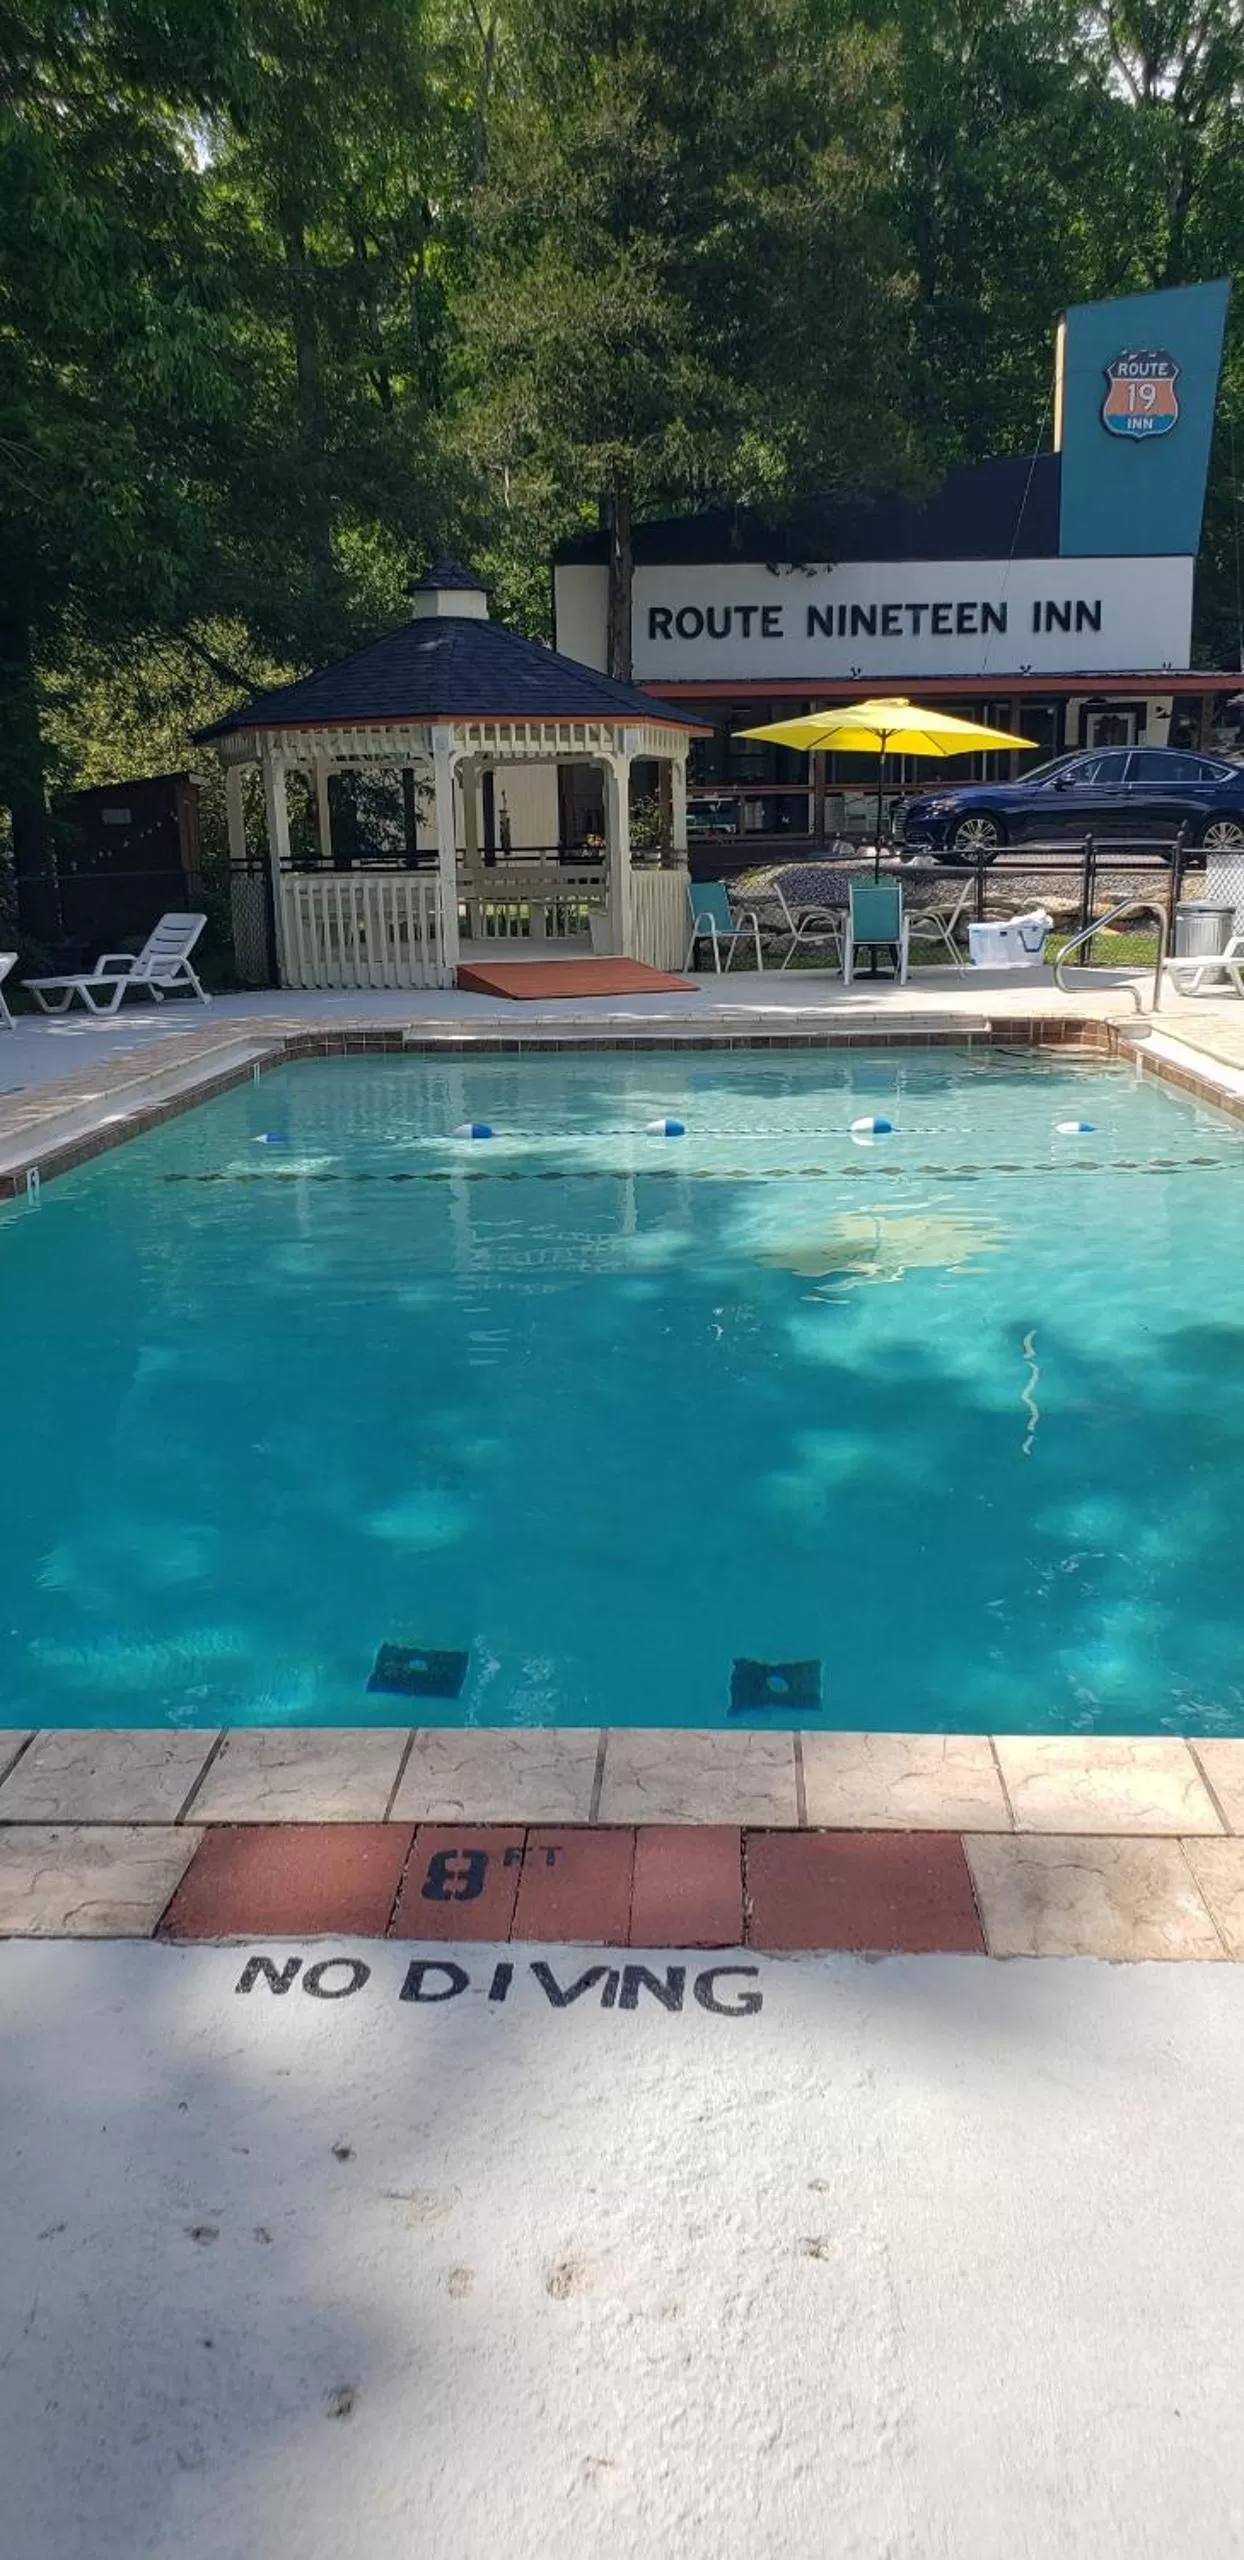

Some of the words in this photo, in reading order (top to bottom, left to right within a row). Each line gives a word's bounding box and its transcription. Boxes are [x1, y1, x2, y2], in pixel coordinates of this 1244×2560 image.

[1117, 362, 1169, 376] ROUTE
[1127, 383, 1156, 412] 19
[1127, 417, 1154, 430] INN
[648, 605, 784, 640] ROUTE
[807, 602, 1007, 637] NINETEEN
[1032, 600, 1102, 633] INN
[421, 1849, 488, 1901] 8
[503, 1845, 563, 1867] FT
[235, 1956, 371, 1999] NO
[399, 1960, 764, 2017] DIVING
